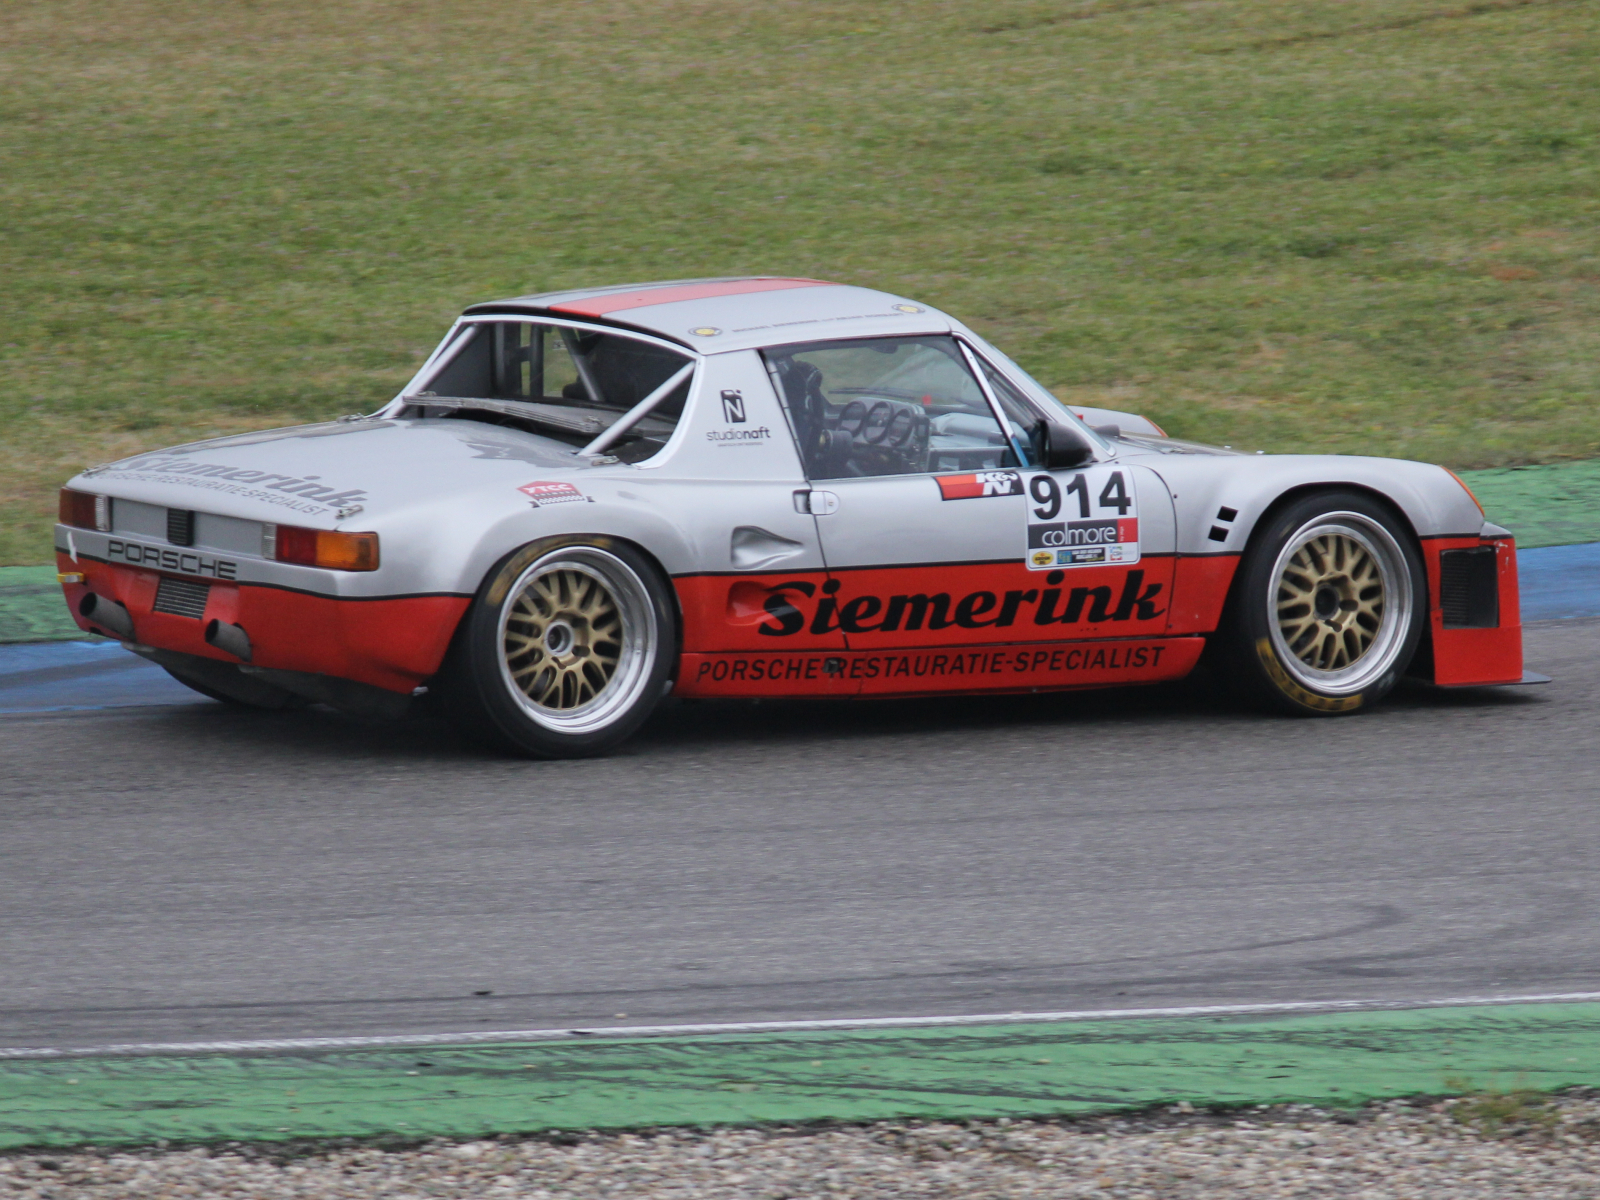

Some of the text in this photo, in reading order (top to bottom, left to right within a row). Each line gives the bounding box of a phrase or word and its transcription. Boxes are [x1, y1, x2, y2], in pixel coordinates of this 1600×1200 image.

[706, 426, 771, 440] studionaft
[108, 456, 368, 508] Siemerink
[523, 484, 572, 493] YTCC
[1029, 470, 1131, 520] 914
[1041, 521, 1117, 546] colmore
[108, 539, 237, 581] PORSCHE
[758, 569, 1166, 637] Siemerink
